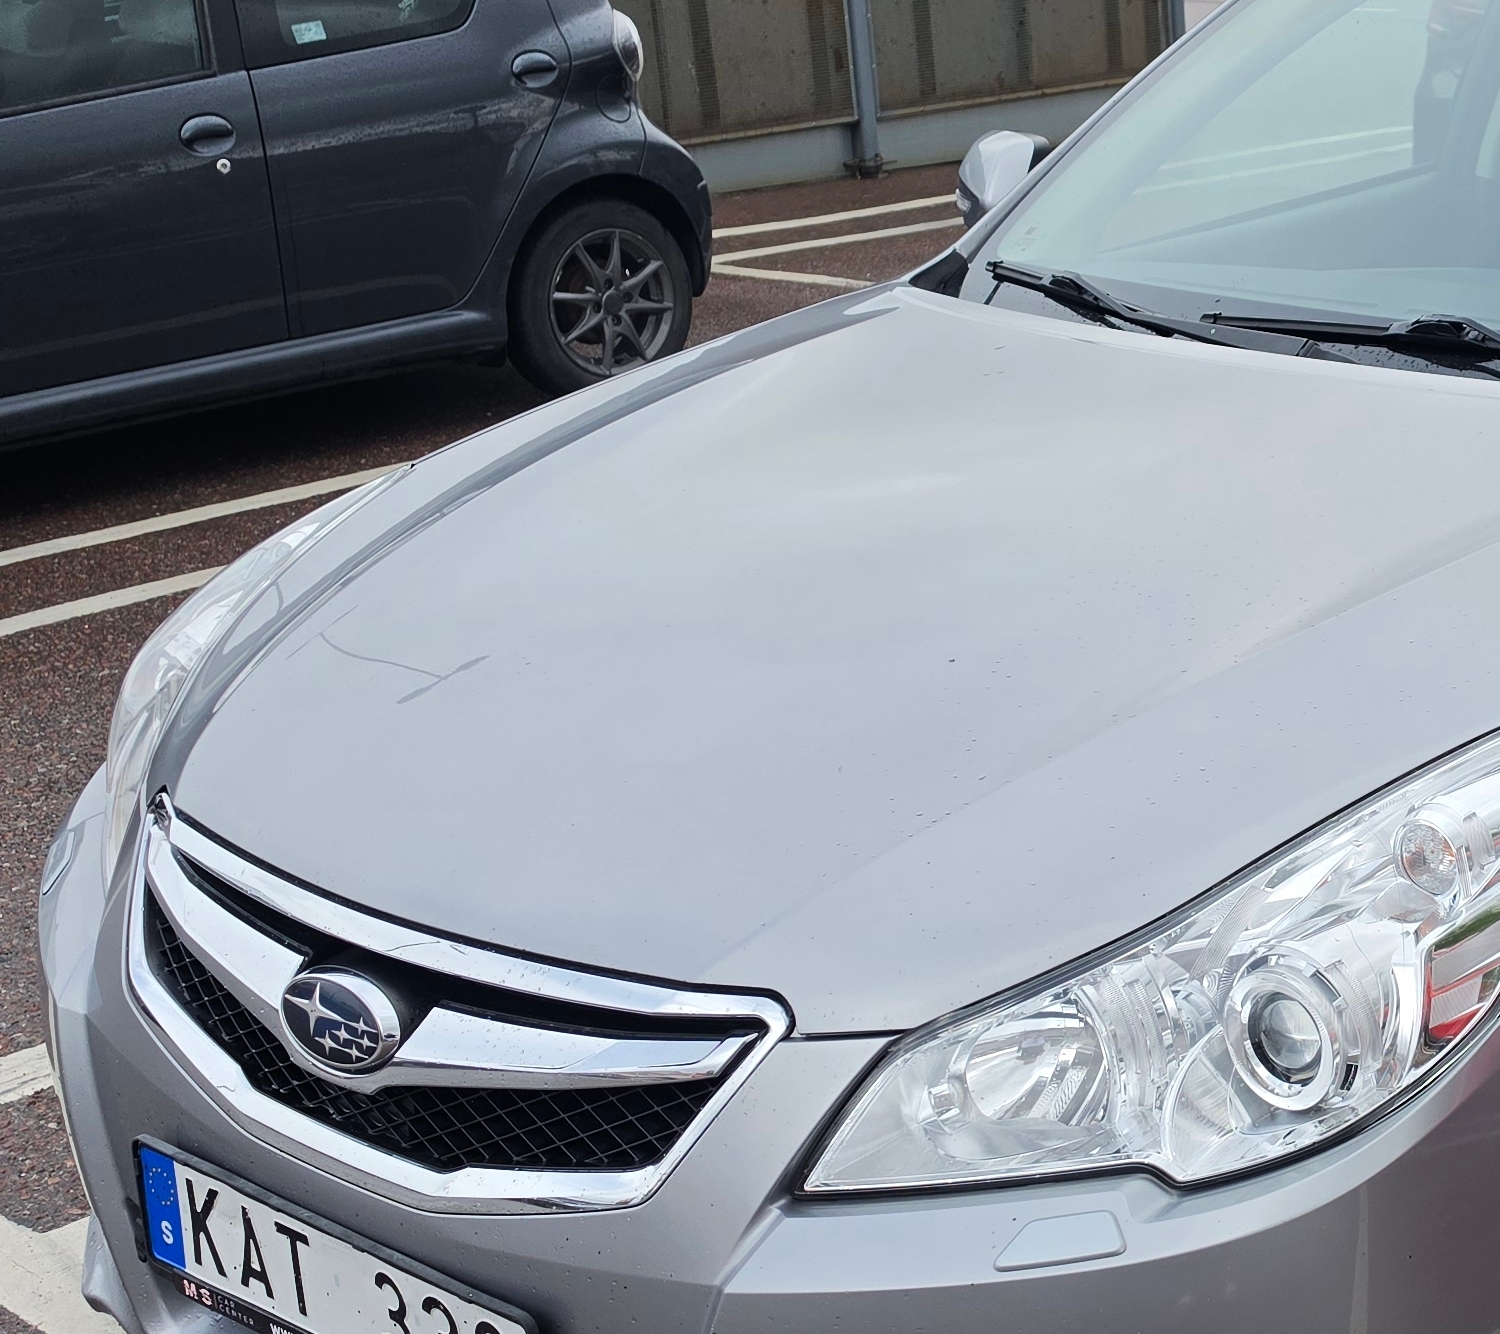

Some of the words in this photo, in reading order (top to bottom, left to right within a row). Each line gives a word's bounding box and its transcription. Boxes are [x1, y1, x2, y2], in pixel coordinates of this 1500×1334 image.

[160, 1220, 174, 1245] S
[185, 1177, 310, 1317] KAT
[217, 1294, 235, 1308] CAR
[218, 1303, 254, 1327] CENTER
